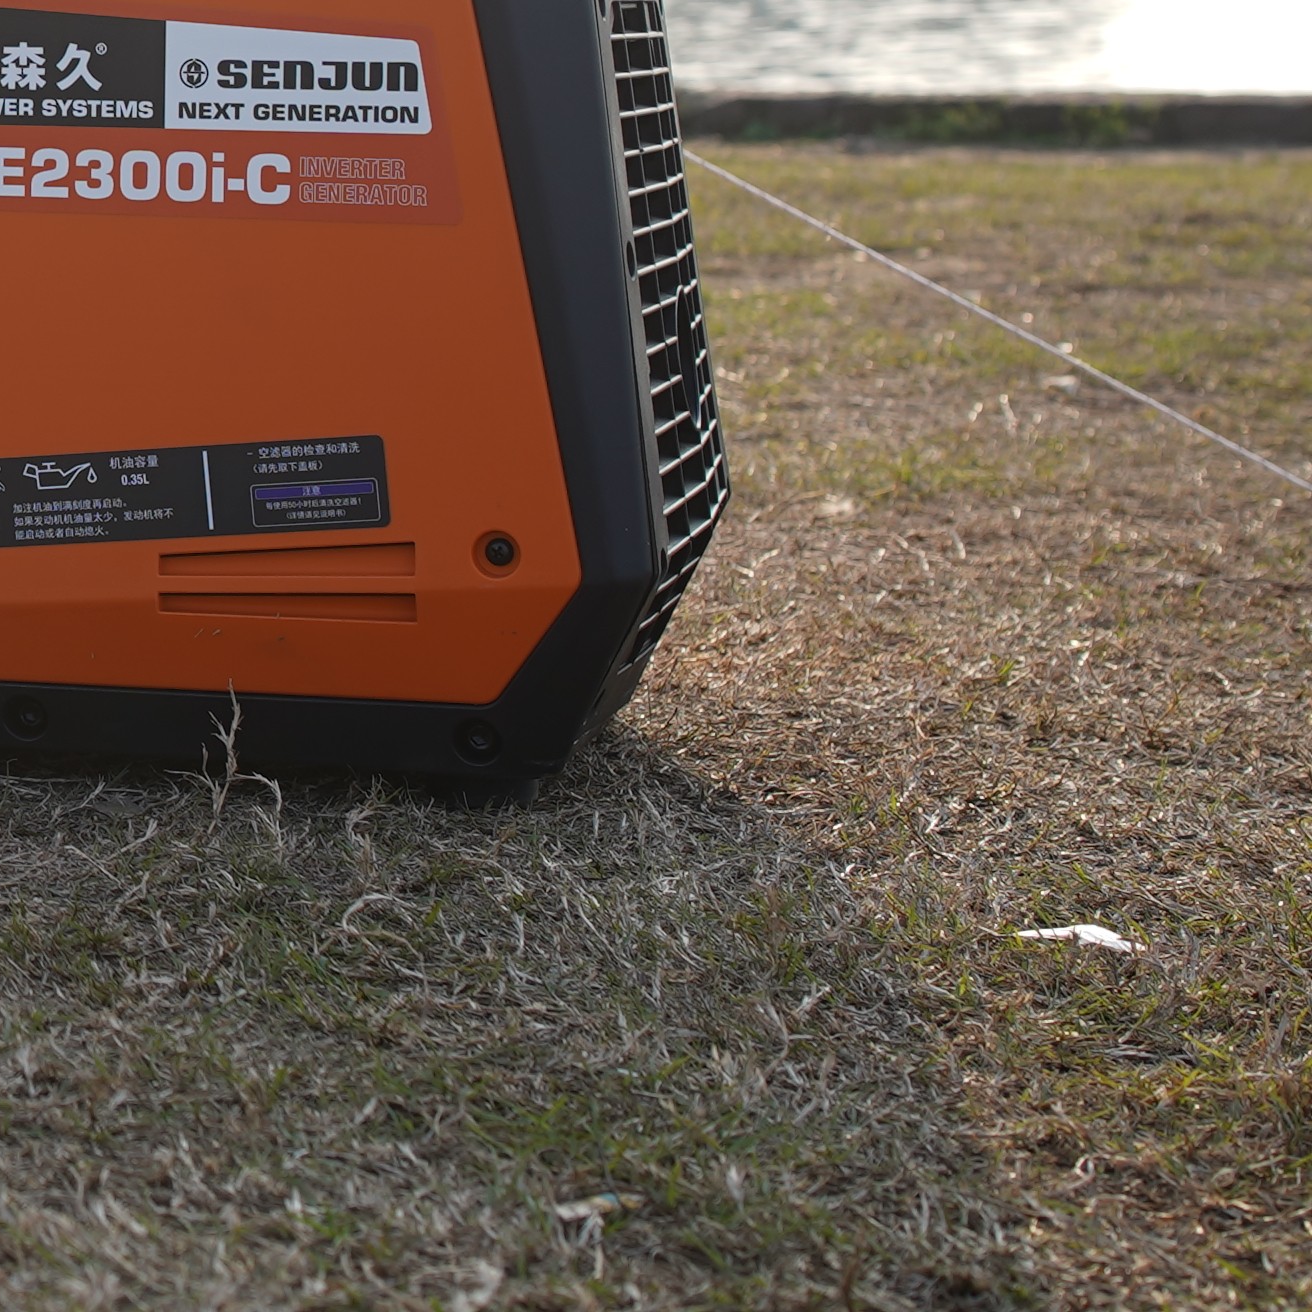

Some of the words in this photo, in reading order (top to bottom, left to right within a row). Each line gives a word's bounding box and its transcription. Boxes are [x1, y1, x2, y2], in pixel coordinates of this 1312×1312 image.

[217, 59, 419, 93] SENJUN
[41, 98, 154, 119] SYSTEMS
[178, 101, 245, 121] NEXT
[253, 103, 419, 124] GENERATION
[299, 156, 406, 180] INVERTER
[299, 181, 428, 206] GENERATOR
[109, 454, 159, 470] 机油容量
[120, 473, 150, 486] 0.35L
